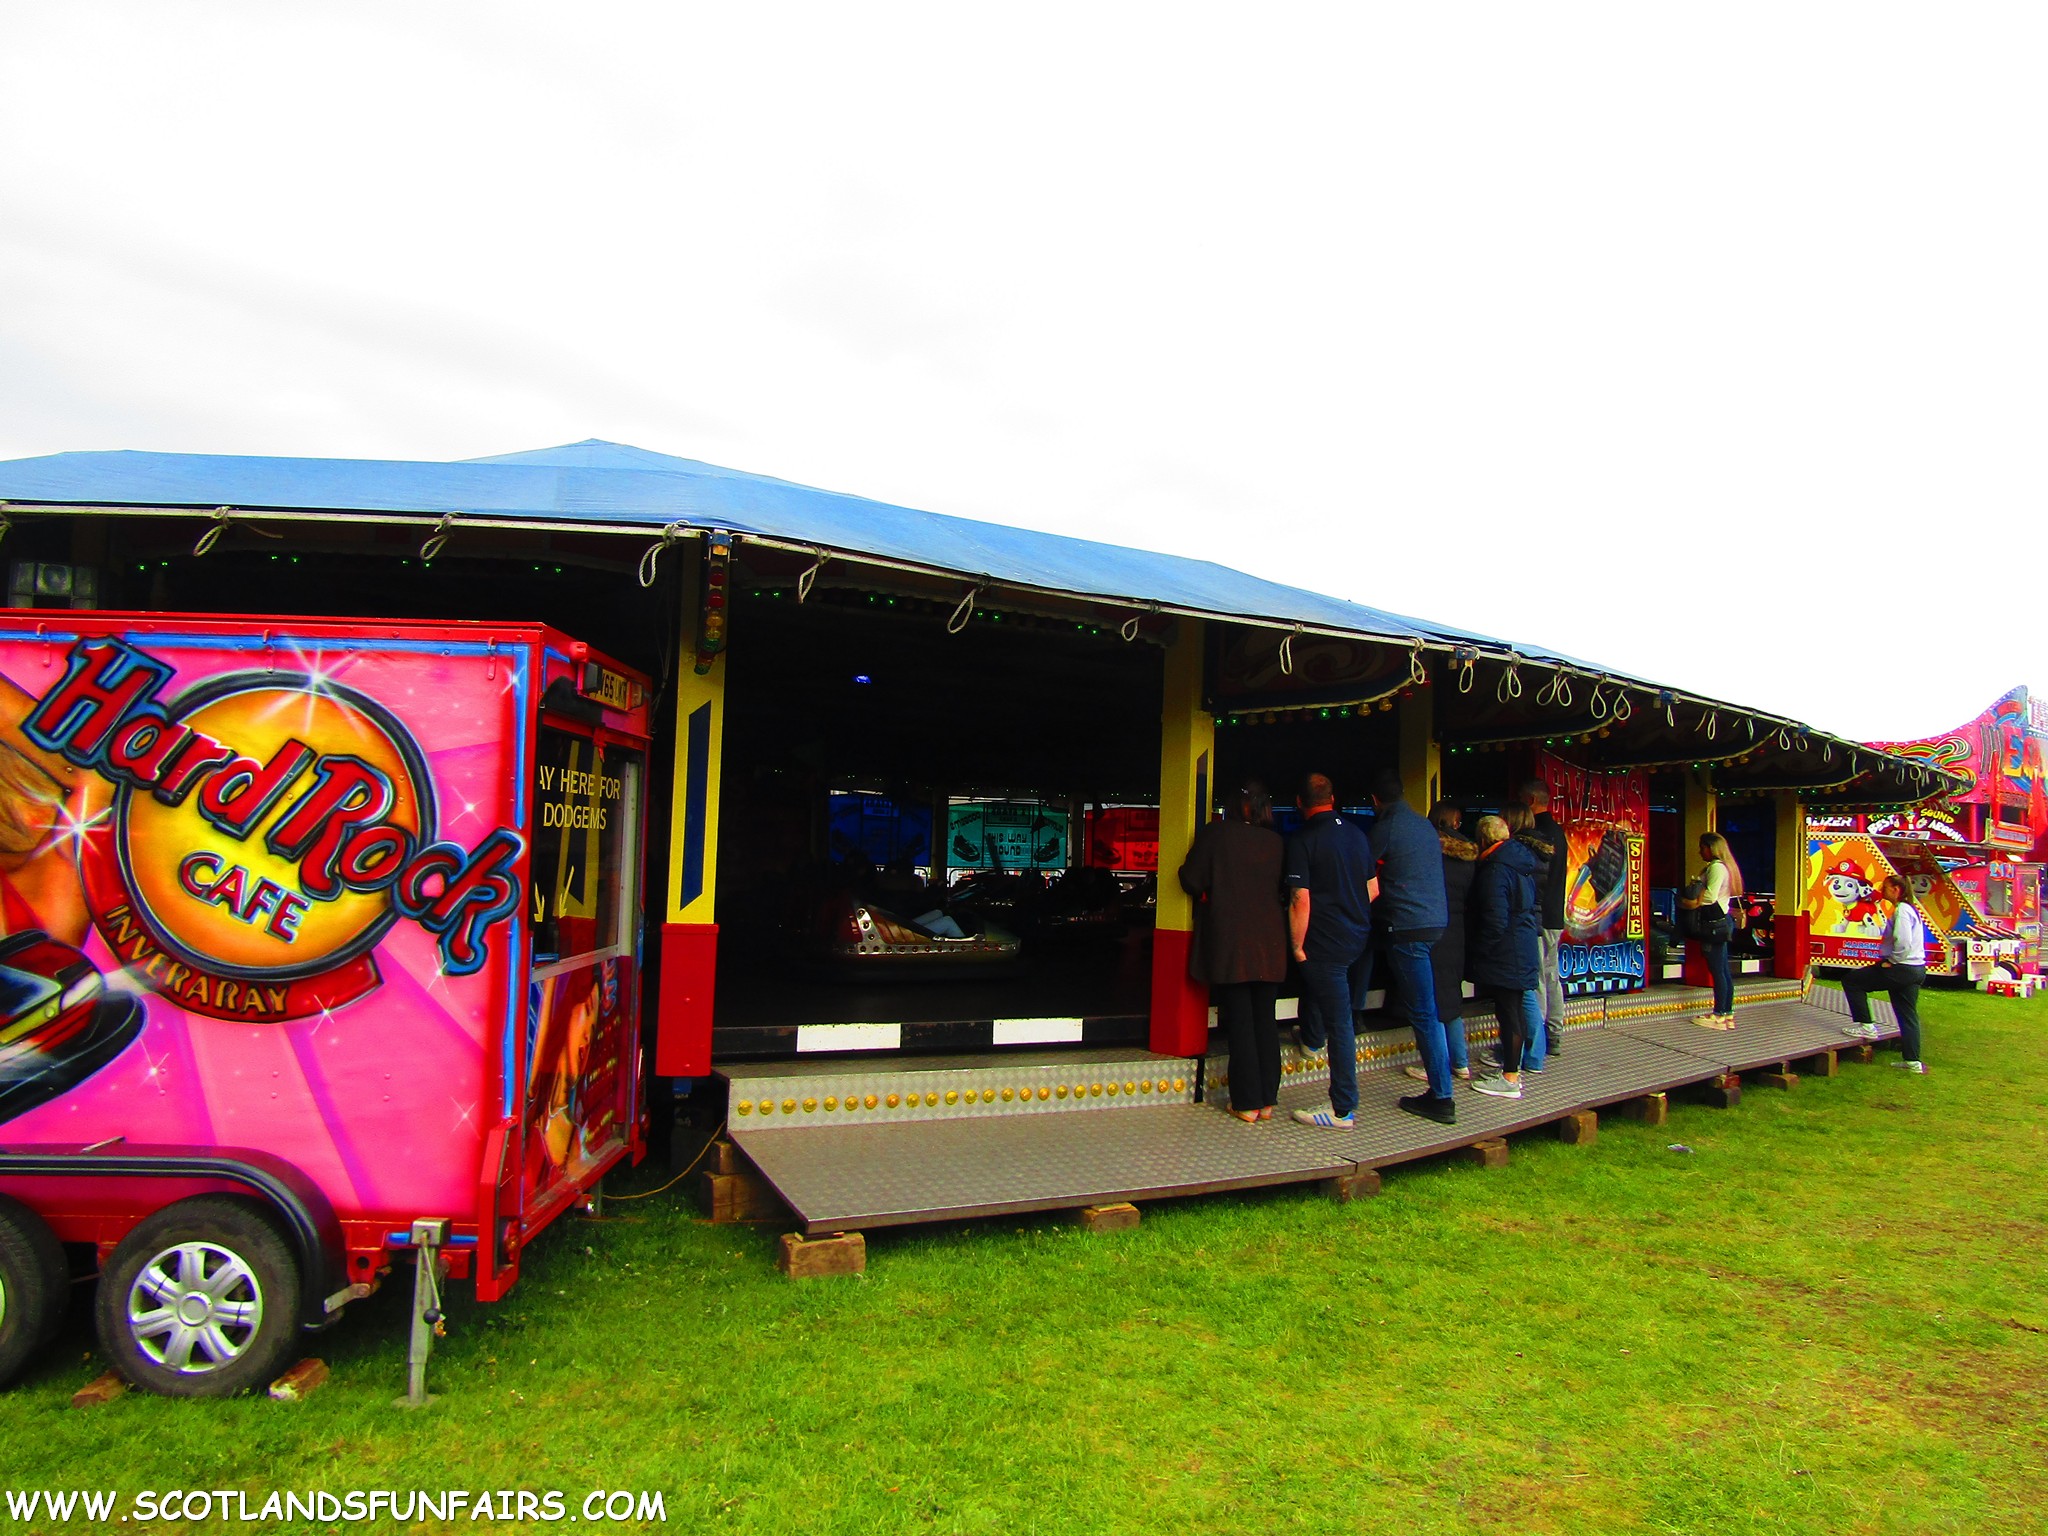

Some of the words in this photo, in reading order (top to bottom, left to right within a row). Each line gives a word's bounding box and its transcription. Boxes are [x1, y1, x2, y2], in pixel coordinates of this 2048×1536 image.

[20, 634, 314, 843] Hard
[266, 752, 527, 977] Rock
[540, 766, 555, 790] AY
[560, 768, 594, 796] HERE
[600, 776, 621, 800] FOR
[543, 802, 607, 830] DODGEMS
[1921, 808, 1955, 824] SOUND
[178, 850, 310, 946] CAFE
[1630, 841, 1643, 935] SUPREME
[104, 904, 290, 1015] INVERARAY
[1557, 939, 1645, 979] ODGEMS
